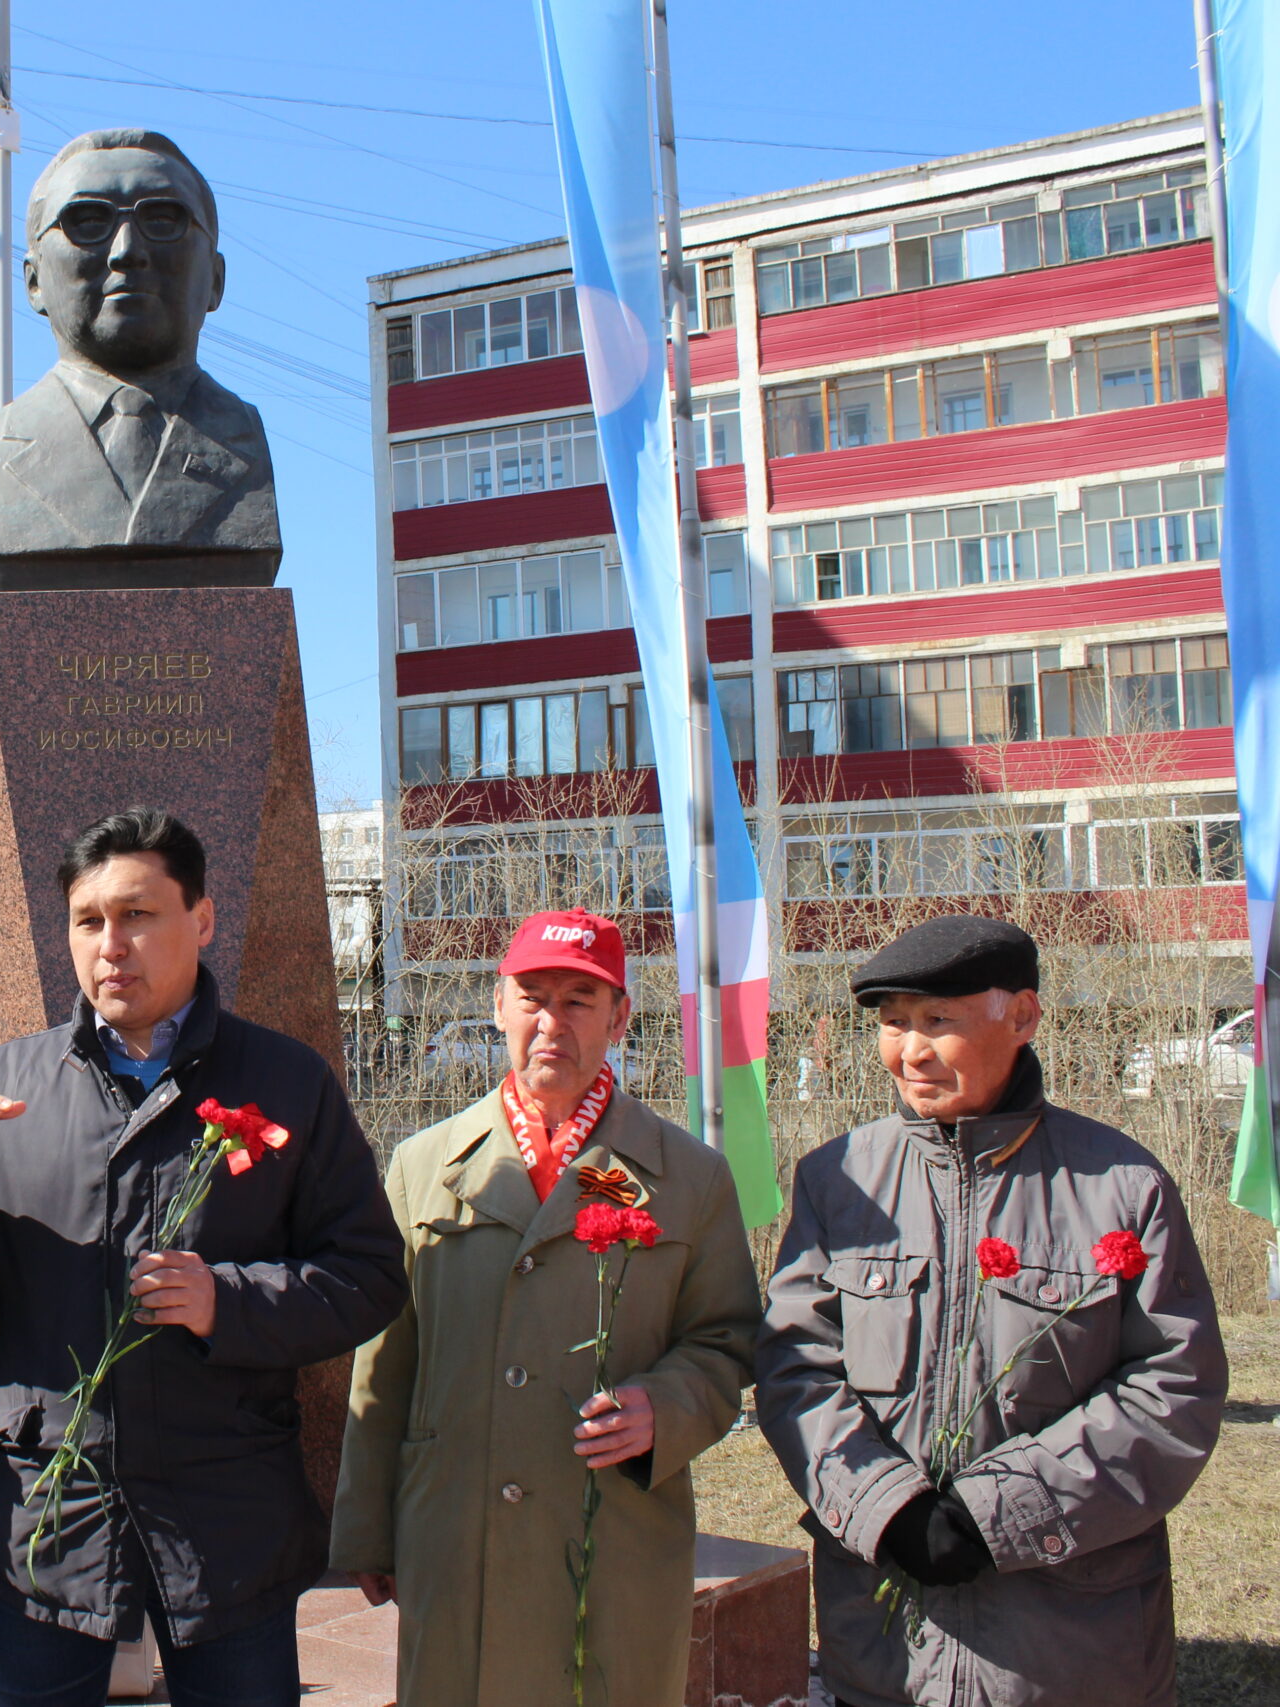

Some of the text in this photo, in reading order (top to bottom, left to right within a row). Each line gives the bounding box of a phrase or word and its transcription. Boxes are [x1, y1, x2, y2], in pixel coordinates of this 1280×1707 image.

[60, 655, 212, 680] ЧИРЯЕВ
[67, 695, 204, 716] ГАВРИИЛ
[40, 728, 233, 750] ИОСИФОВИЧ
[541, 924, 597, 950] КПРФ
